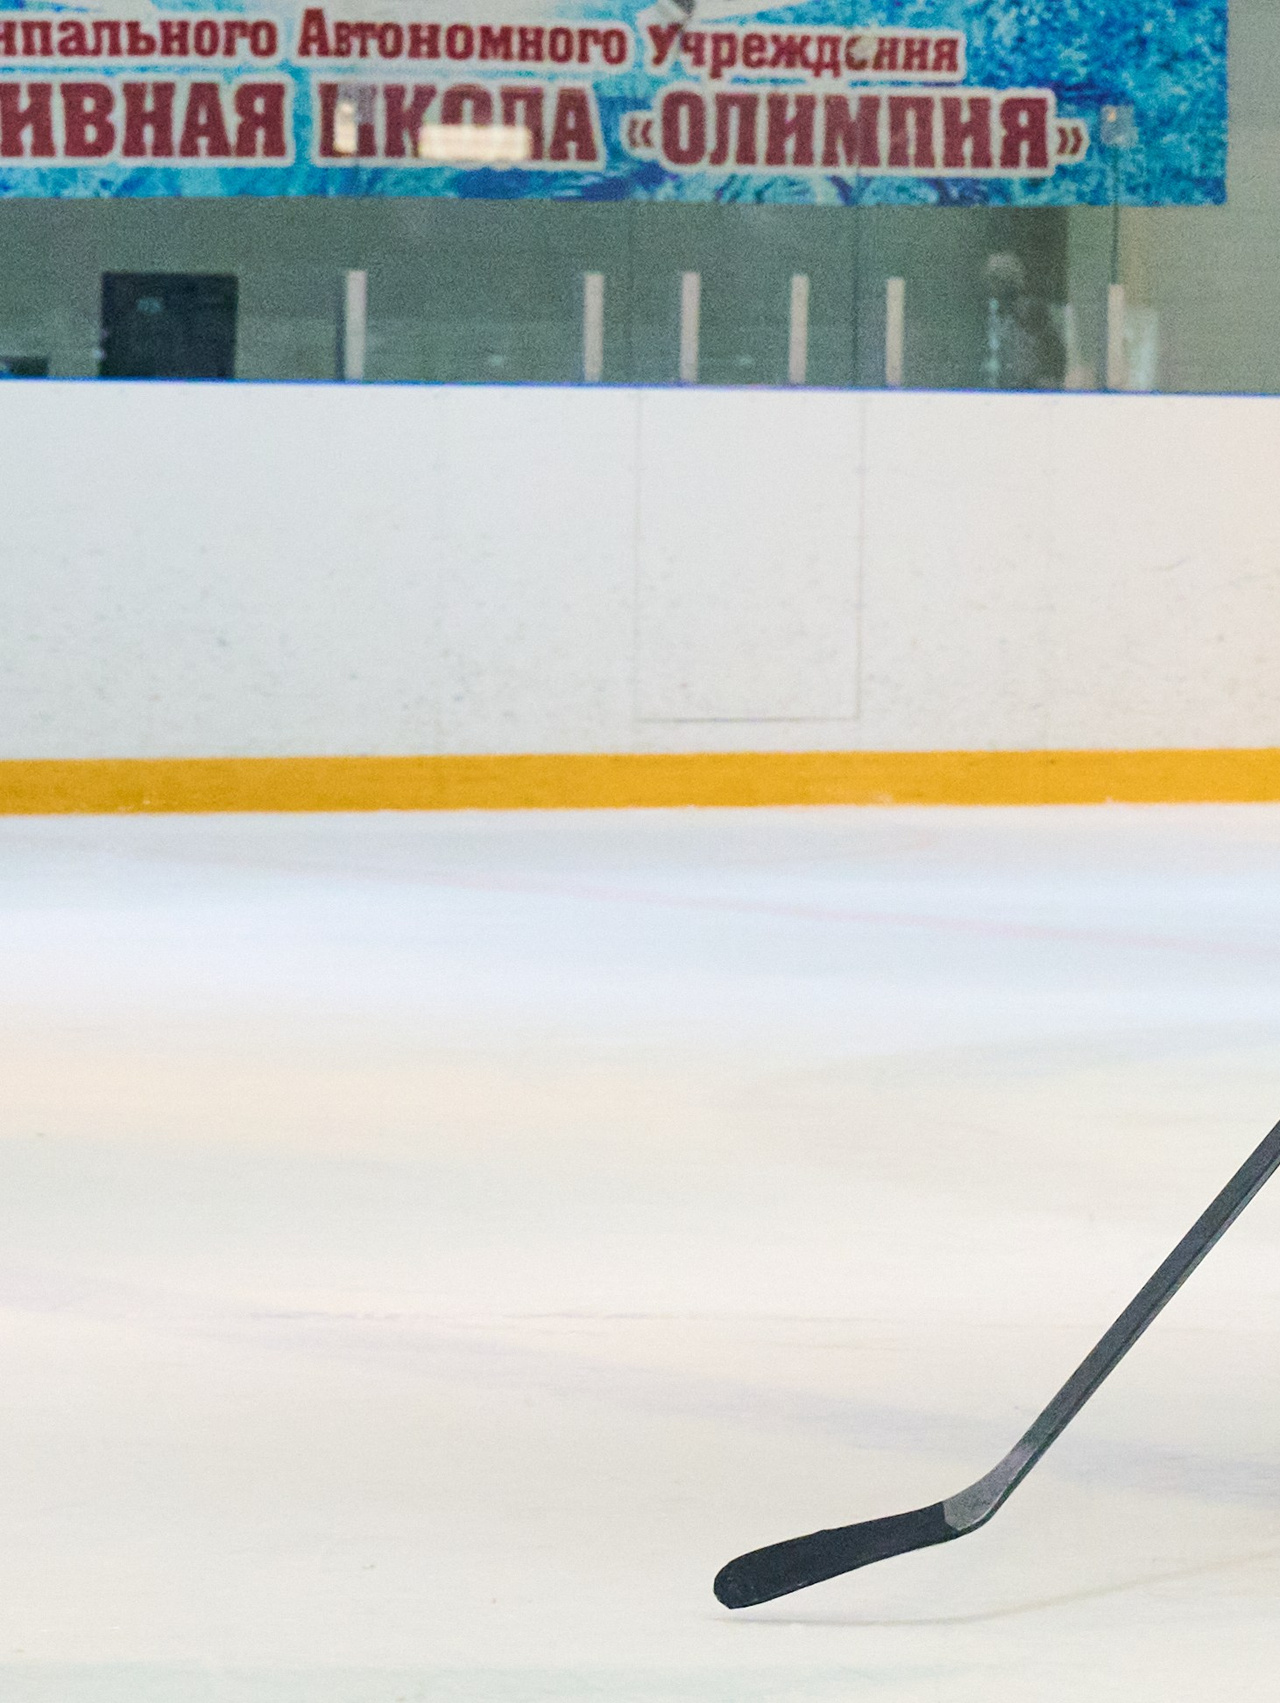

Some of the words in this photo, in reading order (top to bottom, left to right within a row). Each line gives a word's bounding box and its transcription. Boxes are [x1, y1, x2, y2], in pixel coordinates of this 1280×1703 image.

[299, 8, 628, 64] Автономного
[648, 23, 960, 78] Учреждения
[0, 82, 287, 158] ИВНАЯ
[626, 91, 1084, 169] «ОЛИМПИЯ»
